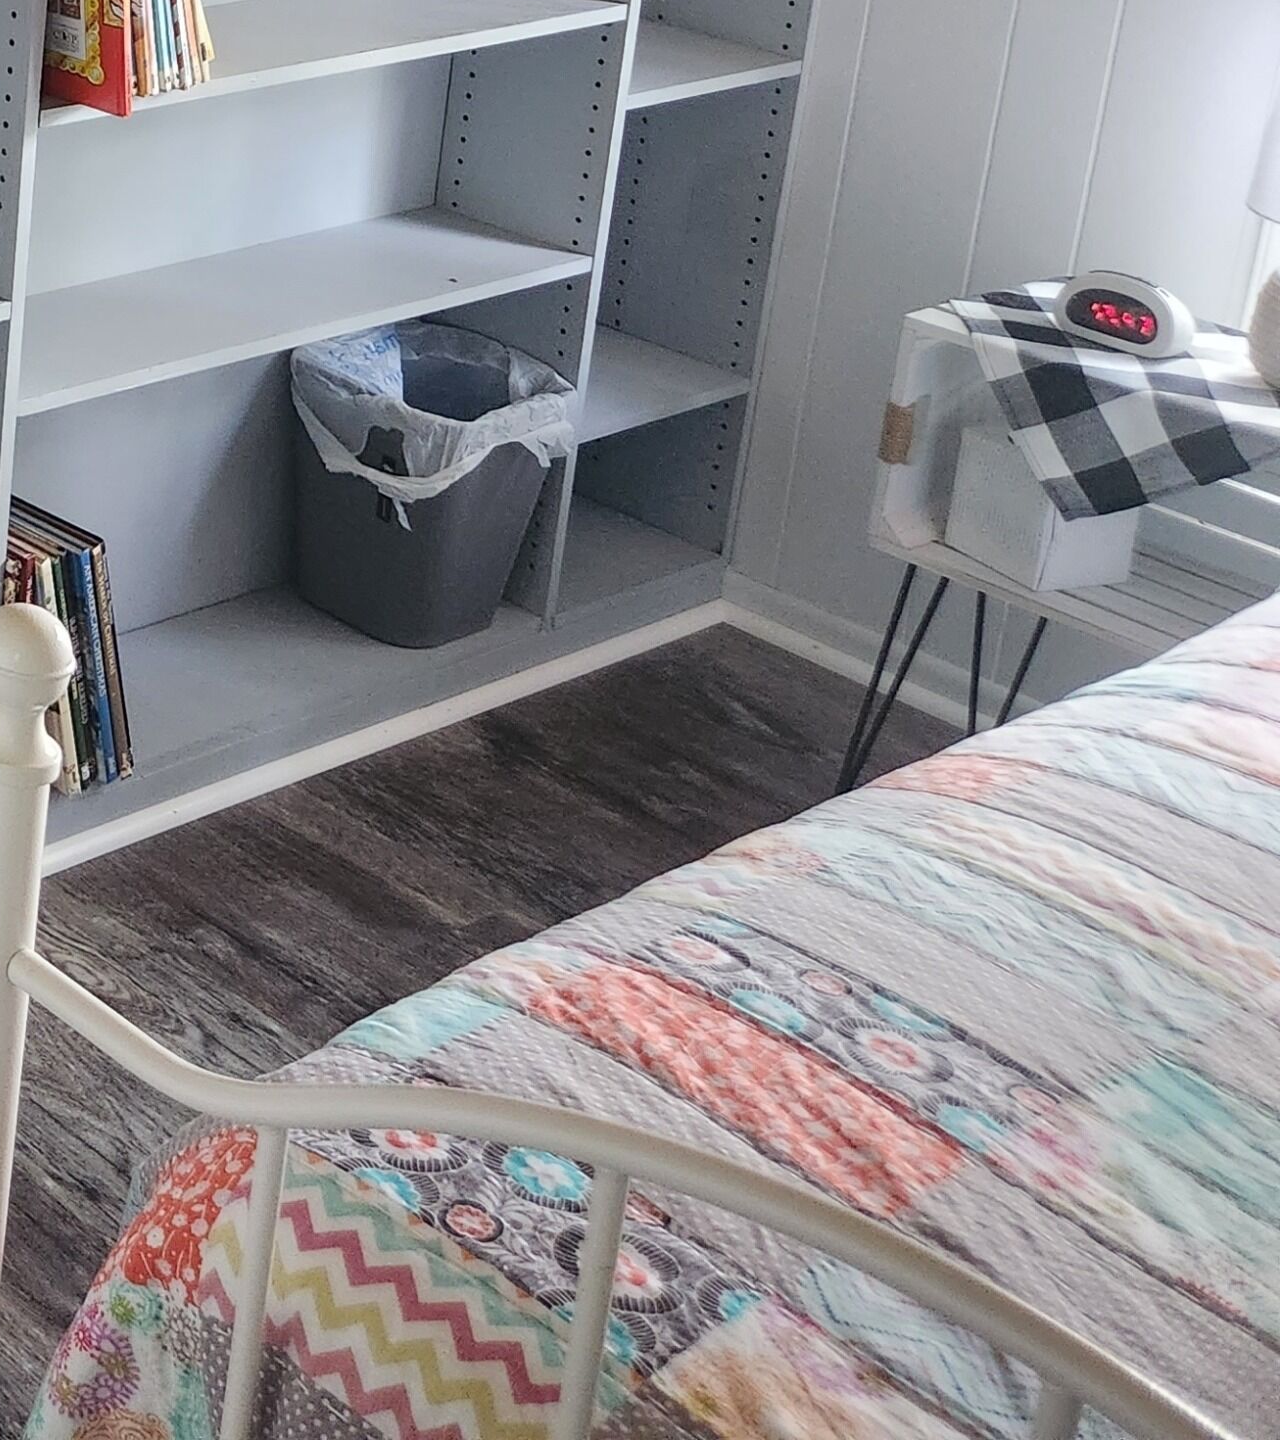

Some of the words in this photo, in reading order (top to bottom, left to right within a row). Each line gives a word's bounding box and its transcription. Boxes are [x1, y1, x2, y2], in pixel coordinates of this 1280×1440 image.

[82, 564, 93, 581] AN
[84, 582, 100, 639] AMERICAN
[90, 638, 107, 697] CHRISTMAS
[102, 623, 118, 675] CHRISTMAS
